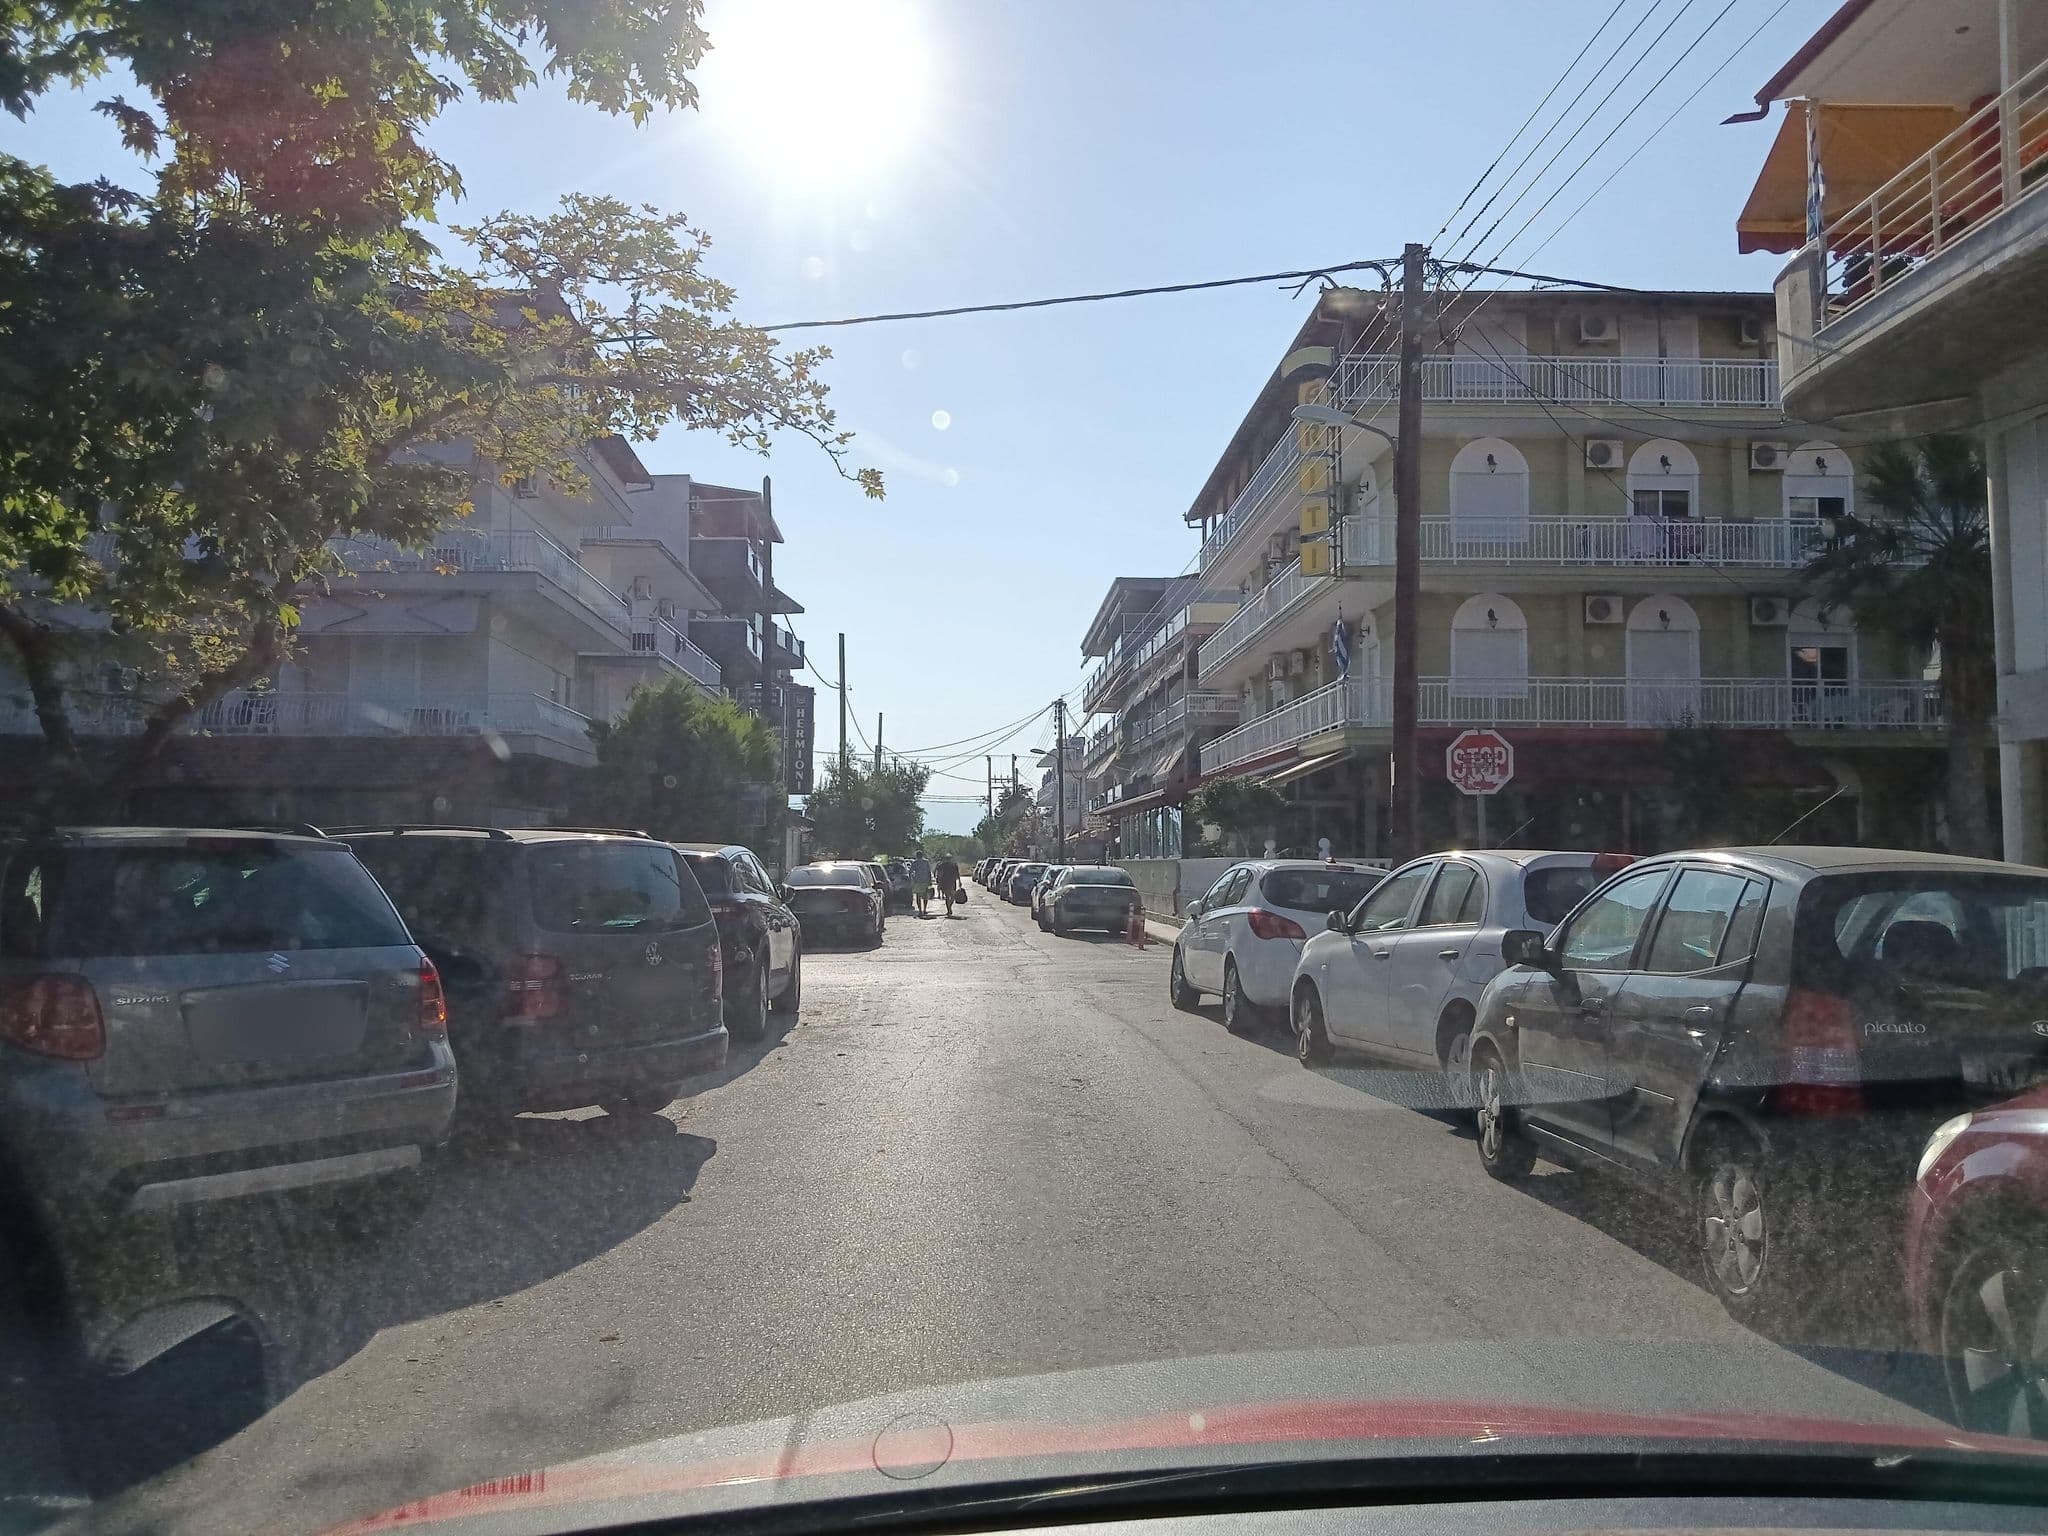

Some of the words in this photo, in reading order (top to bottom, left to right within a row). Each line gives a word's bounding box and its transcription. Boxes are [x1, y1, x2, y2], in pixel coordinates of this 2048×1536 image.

[795, 708, 806, 790] HERMIONI
[1453, 746, 1507, 779] STOP
[1864, 1020, 1926, 1036] picanto
